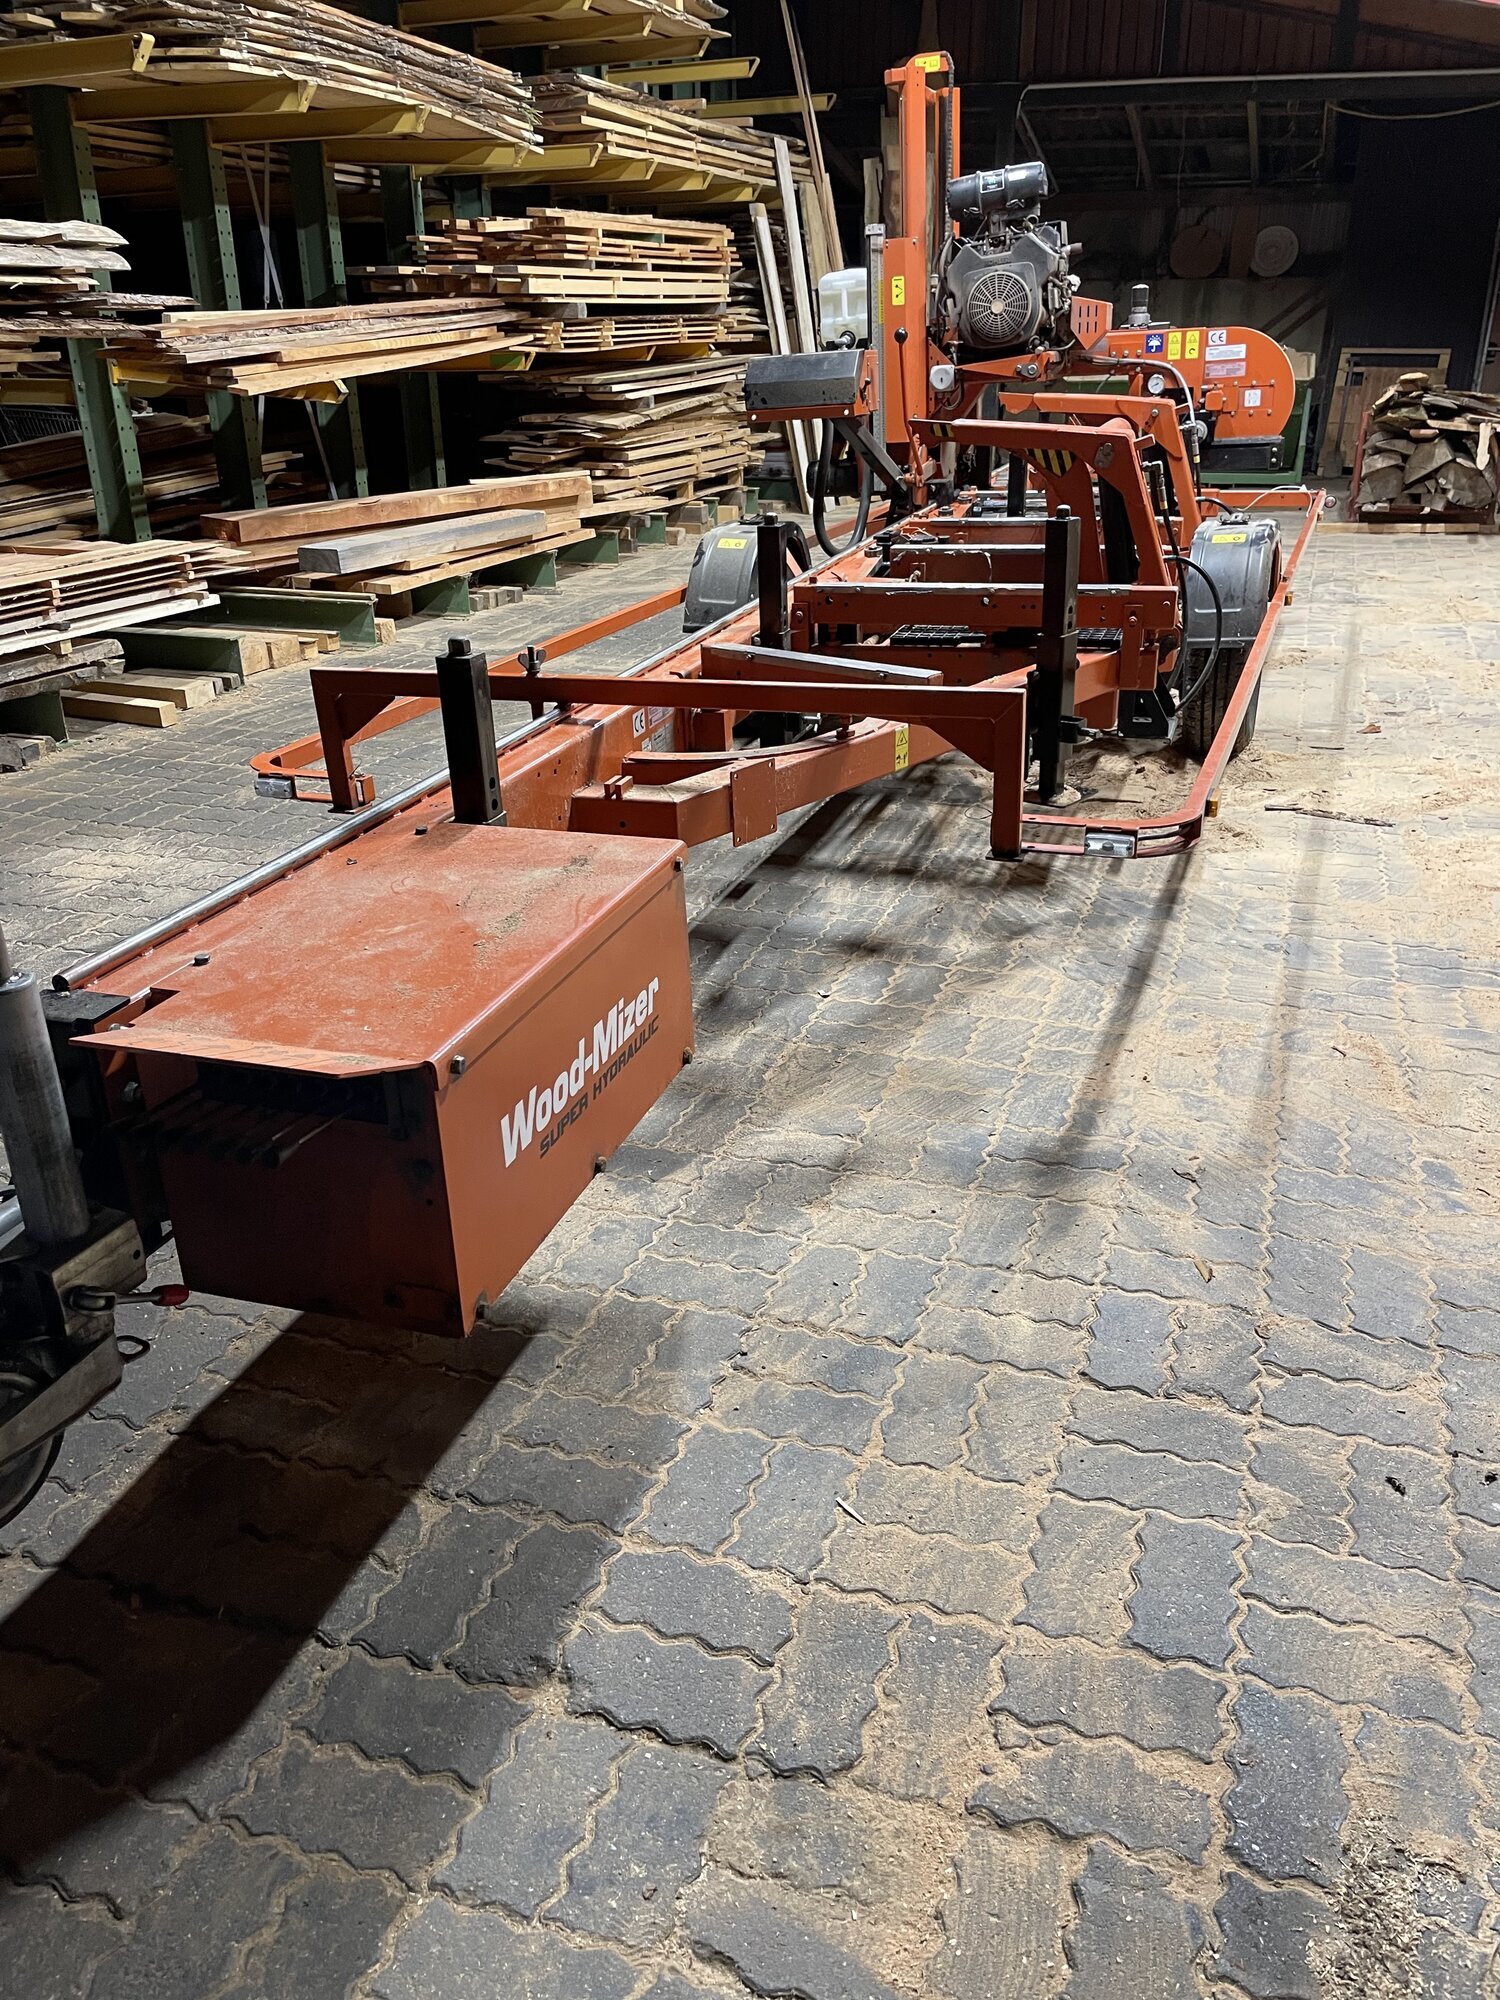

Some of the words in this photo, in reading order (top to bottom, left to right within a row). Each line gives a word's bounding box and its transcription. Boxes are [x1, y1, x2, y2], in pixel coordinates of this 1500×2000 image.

[1210, 332, 1224, 343] CE
[634, 712, 644, 732] CE
[500, 976, 659, 1168] Wood-Mizer
[540, 1092, 588, 1159] SUPER
[593, 1014, 660, 1100] HYDRAULIC
